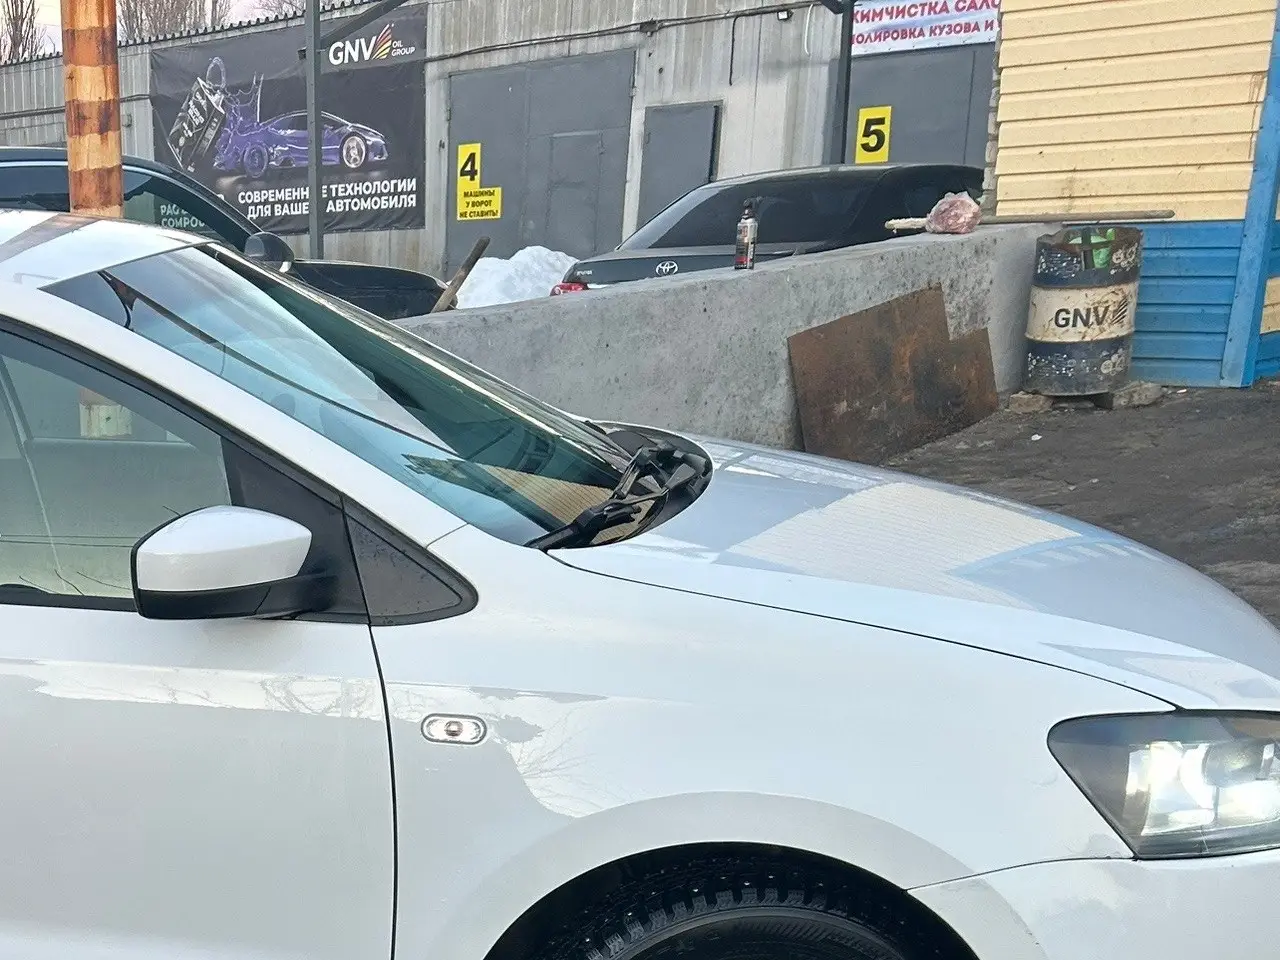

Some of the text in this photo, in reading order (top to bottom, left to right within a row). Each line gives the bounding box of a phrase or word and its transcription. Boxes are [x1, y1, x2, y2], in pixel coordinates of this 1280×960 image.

[928, 22, 981, 37] КУЗОВА
[984, 20, 994, 31] И
[329, 36, 377, 65] GNV
[391, 46, 416, 57] GROUP
[392, 40, 403, 48] OIL
[860, 117, 886, 153] 5
[460, 152, 478, 181] 4
[238, 178, 417, 204] СОВРЕМЕННЕ ТЕХНОЛОГИИ
[463, 190, 495, 198] МАШИНЫ
[247, 194, 417, 220] ДЛЯ ВАШЕ АВТОМОБИЛЯ
[468, 210, 499, 218] СТАВИТЬ!
[1054, 305, 1111, 328] GNV
